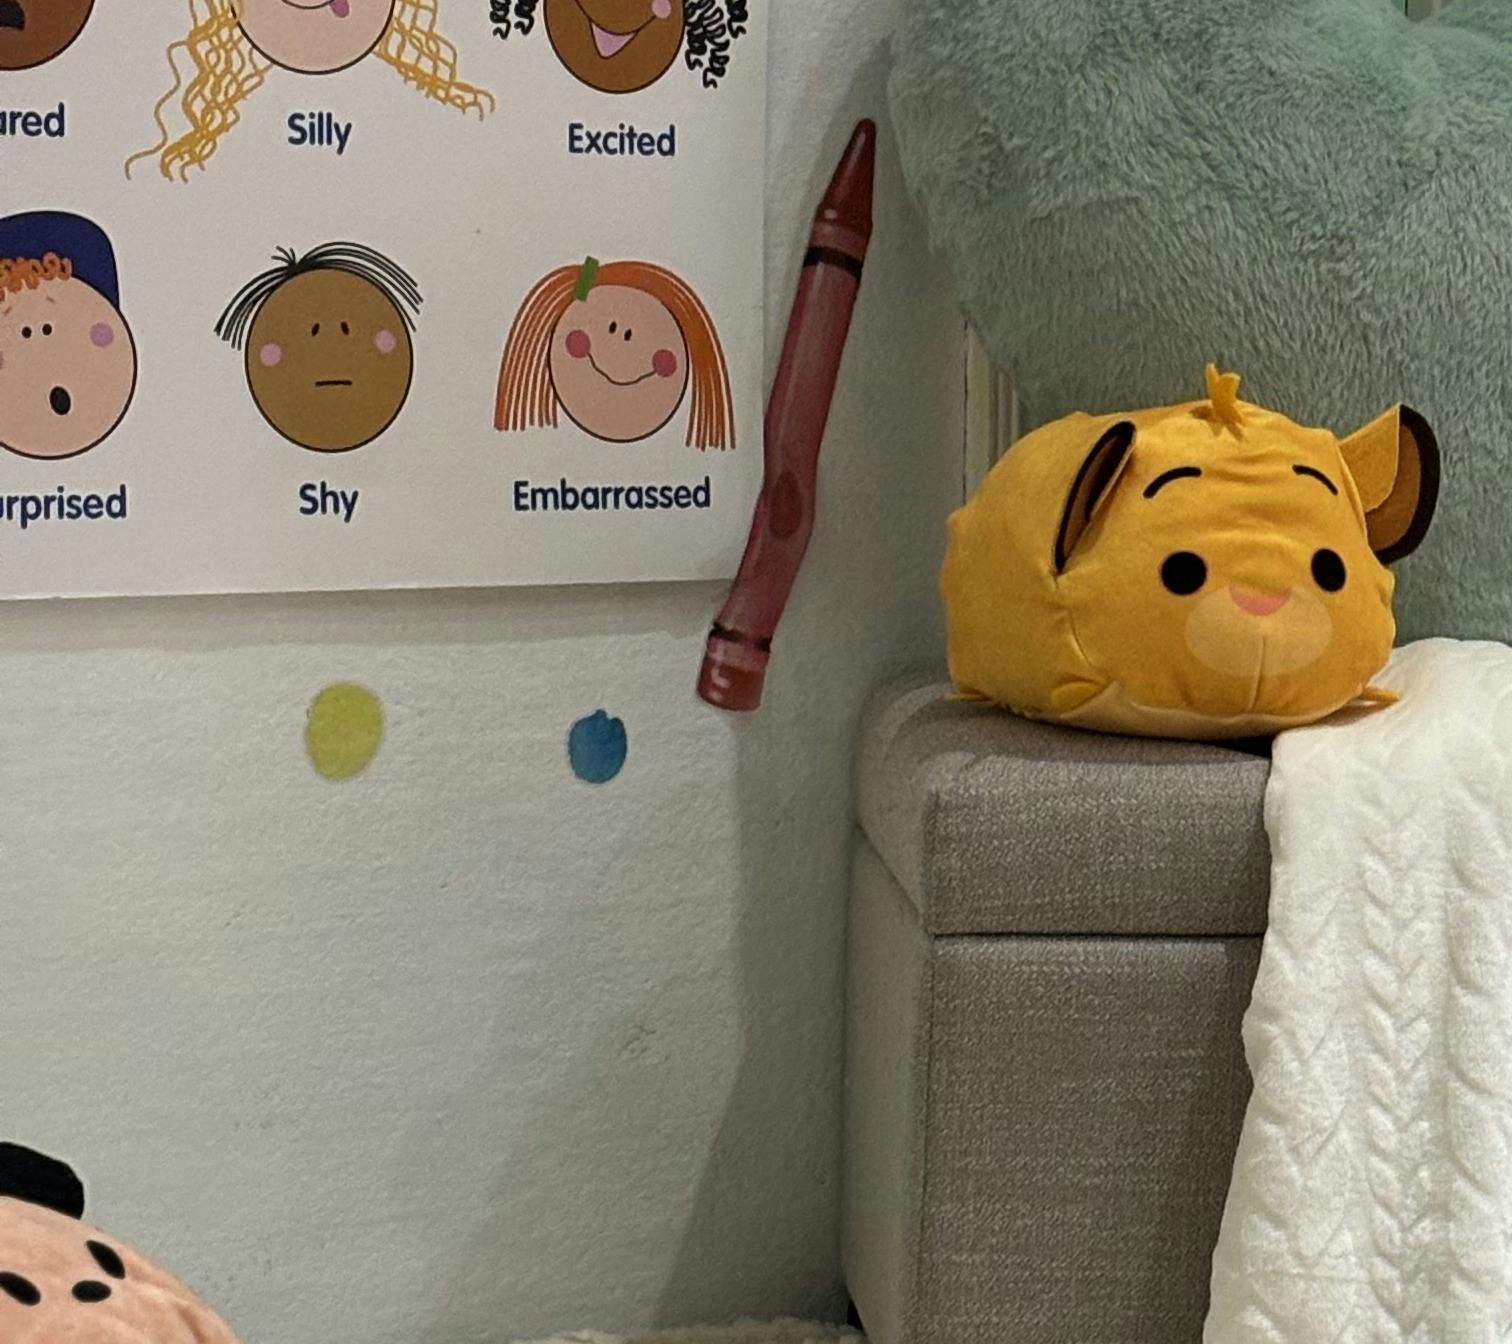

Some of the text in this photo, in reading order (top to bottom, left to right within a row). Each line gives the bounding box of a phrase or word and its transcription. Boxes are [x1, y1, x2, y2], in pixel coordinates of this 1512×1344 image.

[287, 112, 352, 155] Silly
[568, 123, 676, 157] Excited
[0, 484, 126, 529] rprised
[299, 481, 359, 523] Shy
[513, 475, 711, 512] Embarrassed
